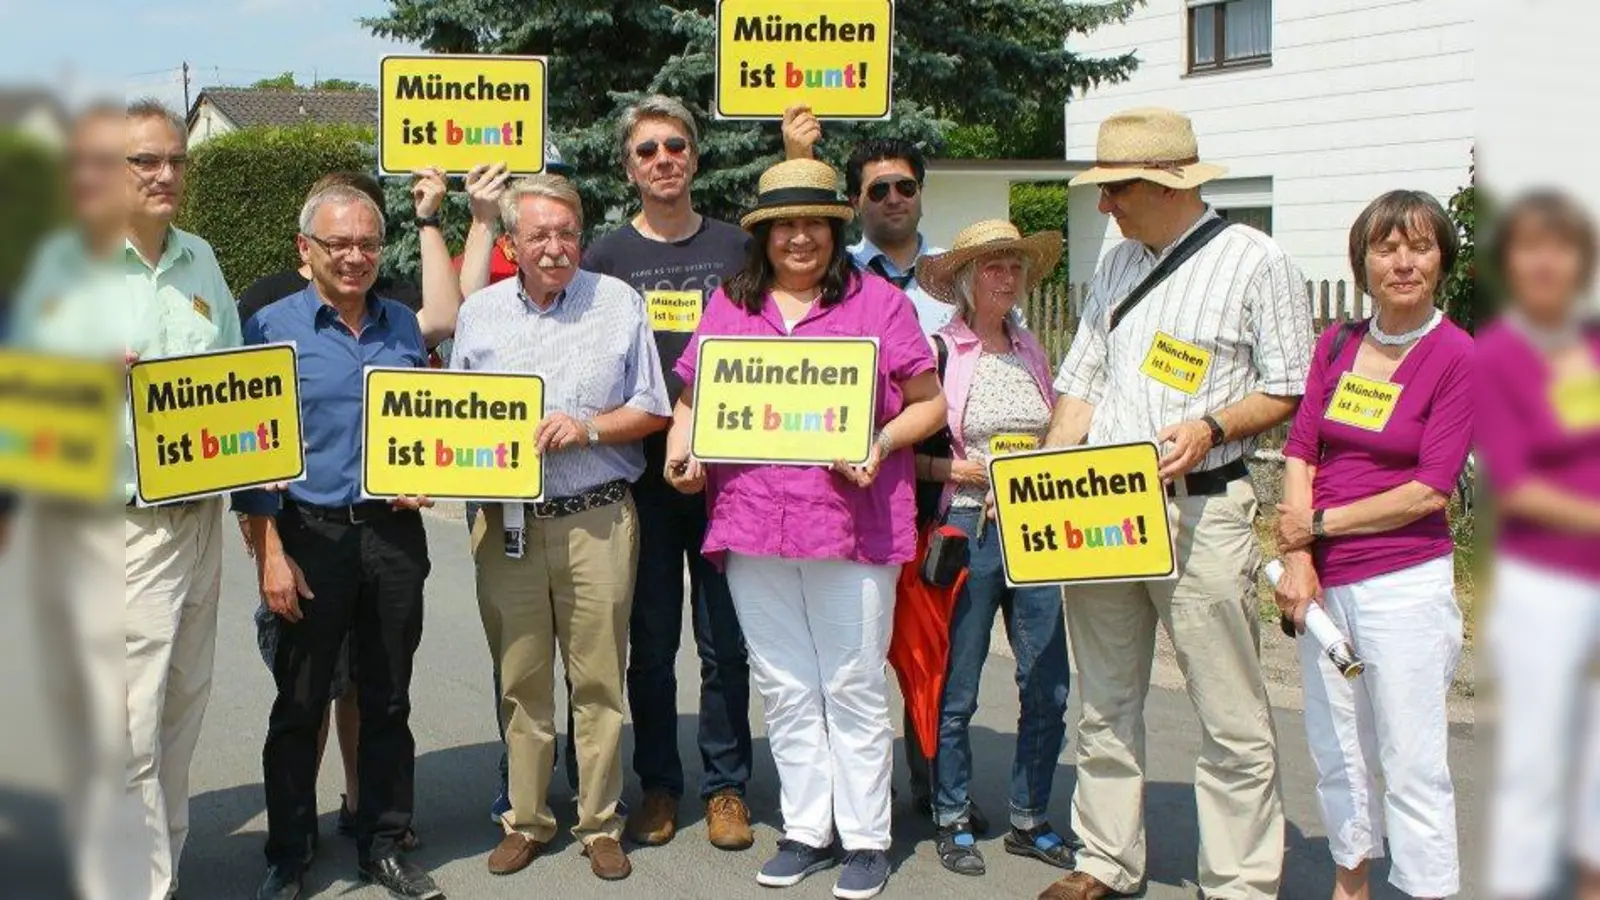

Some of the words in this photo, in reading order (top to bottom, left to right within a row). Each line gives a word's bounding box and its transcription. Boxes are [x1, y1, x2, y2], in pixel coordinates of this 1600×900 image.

[734, 15, 875, 42] München
[396, 74, 530, 101] München
[740, 61, 775, 88] ist
[785, 62, 868, 88] bunt!
[402, 118, 437, 145] ist
[446, 119, 523, 145] bunt!
[1156, 340, 1204, 367] München
[714, 357, 858, 386] München
[147, 372, 282, 413] München
[381, 390, 527, 420] München
[1344, 382, 1392, 402] München
[717, 402, 753, 430] ist
[763, 403, 848, 433] bunt!
[156, 433, 194, 466] ist
[201, 419, 279, 460] bunt!
[388, 437, 425, 466] ist
[435, 439, 519, 469] bunt!
[1009, 468, 1147, 504] München
[1020, 523, 1058, 552] ist
[1064, 516, 1148, 550] bunt!
